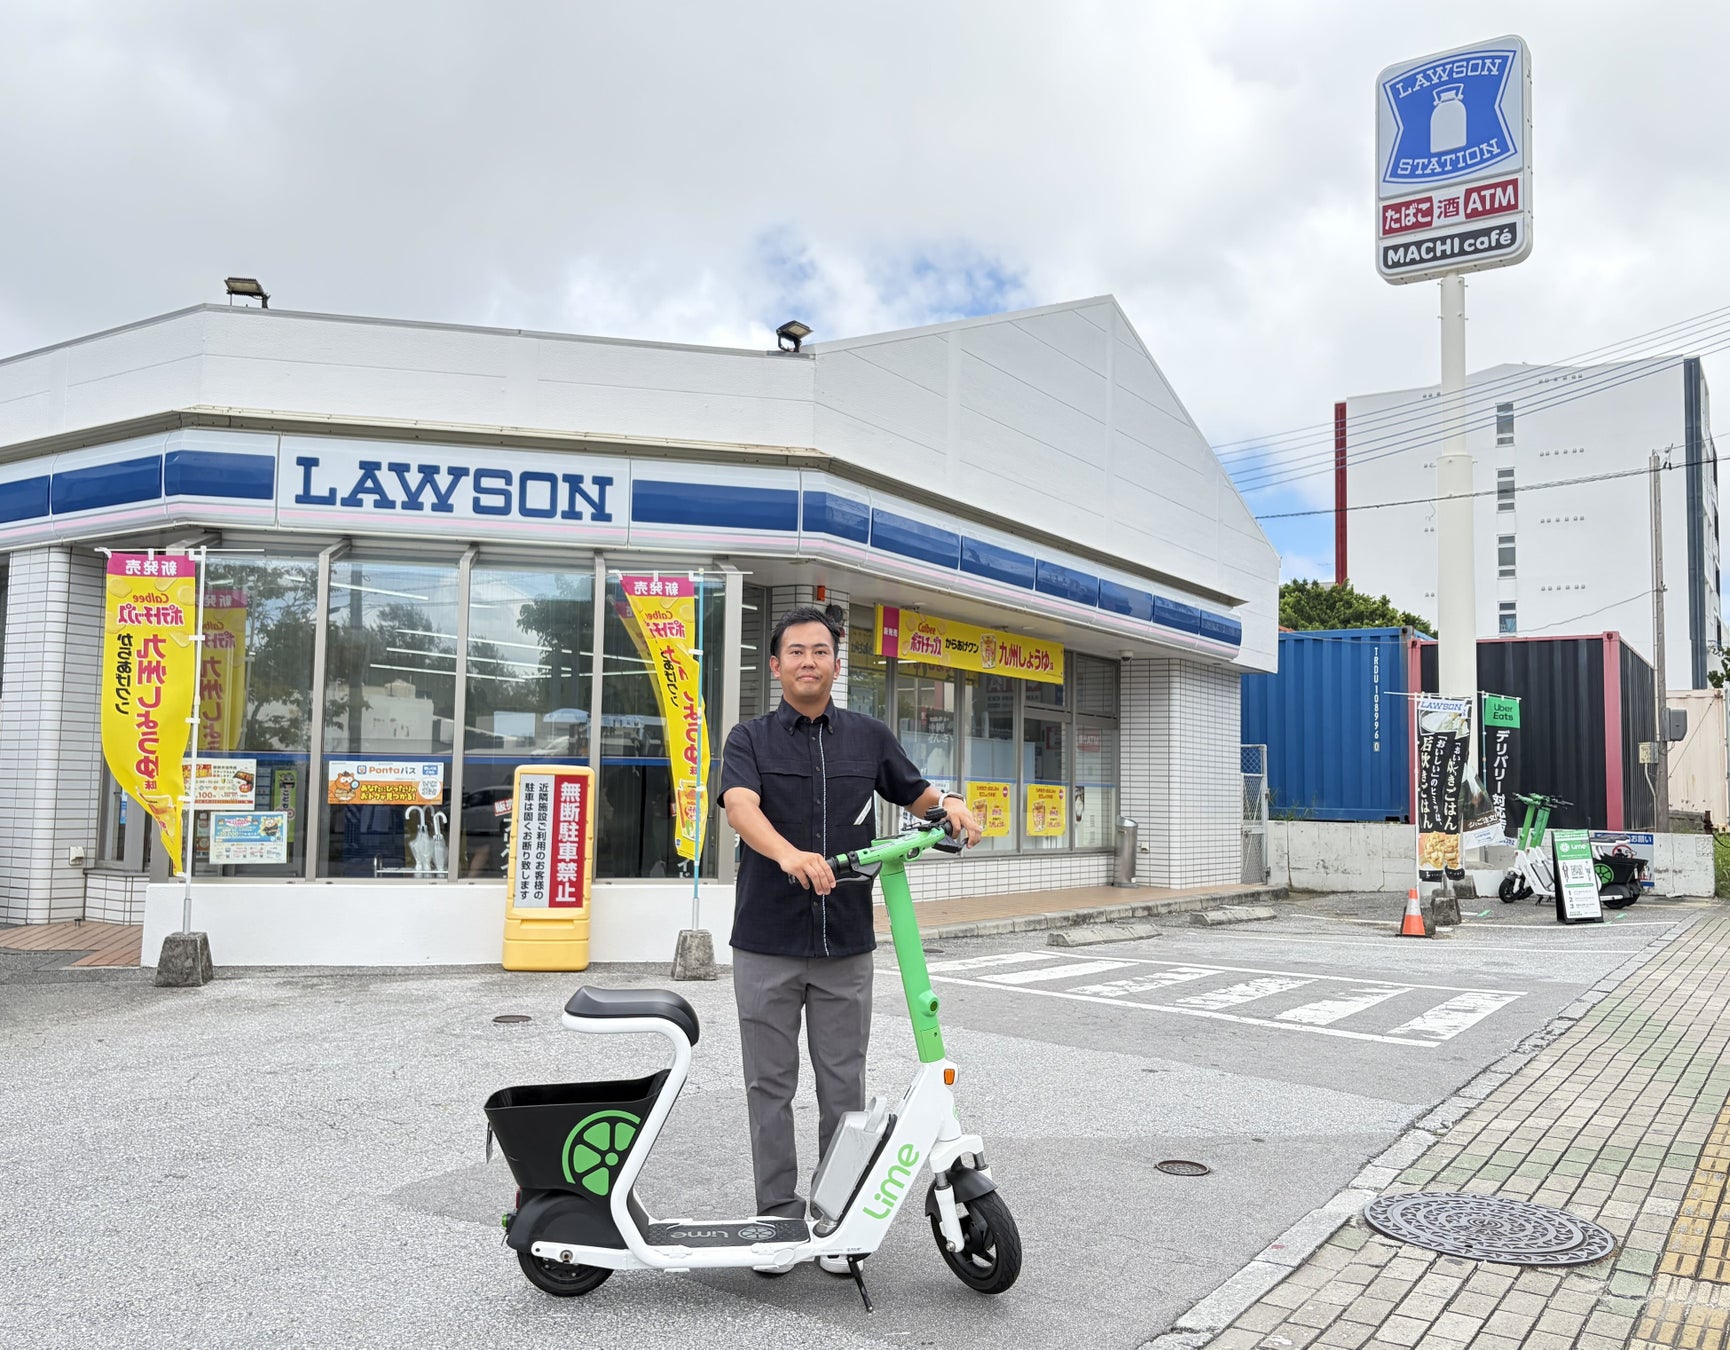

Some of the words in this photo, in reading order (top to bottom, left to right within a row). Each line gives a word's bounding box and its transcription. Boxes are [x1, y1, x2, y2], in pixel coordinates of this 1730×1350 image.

[1396, 59, 1502, 99] LAWSON
[1397, 138, 1501, 175] STATION
[1385, 201, 1432, 231] たばこ
[1437, 196, 1460, 220] 酒
[1466, 185, 1516, 214] ATM
[1387, 238, 1459, 266] MACHI
[1463, 227, 1513, 252] café
[295, 456, 614, 522] LAWSON
[945, 638, 979, 653] からあげクン
[1493, 712, 1513, 721] Eats
[1494, 703, 1513, 712] Uber
[520, 782, 535, 900] 駐車は固くお断り致します
[534, 782, 549, 900] 近隣施設ご利用のお客様の
[555, 781, 581, 902] 無断駐車禁止
[862, 1143, 920, 1221] Lime
[671, 1229, 728, 1239] Lime
